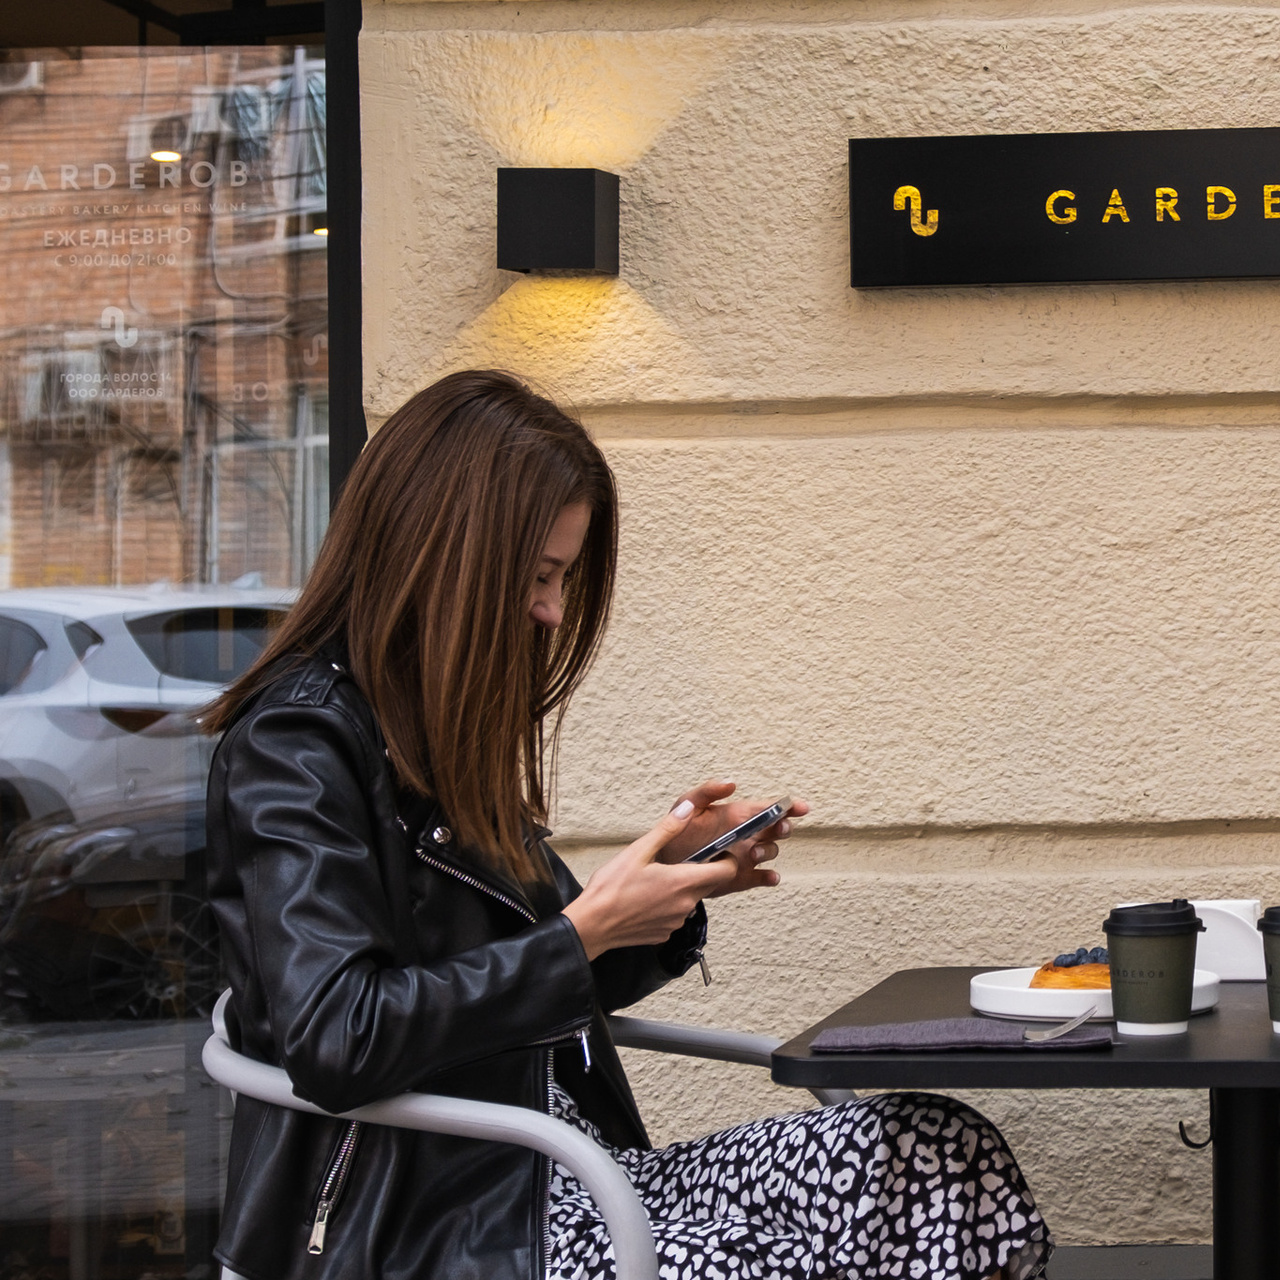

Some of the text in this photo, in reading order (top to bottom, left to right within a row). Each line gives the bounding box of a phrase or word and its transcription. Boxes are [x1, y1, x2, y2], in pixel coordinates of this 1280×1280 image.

[0, 202, 247, 218] OASTERY BAKERY KITCHEN WINE
[43, 227, 192, 248] ЕЖЕДНЕВНО
[54, 253, 176, 268] С 9:00 ДО 21:00
[60, 373, 110, 384] ГОРОДА
[114, 372, 158, 383] ВОЛОС
[68, 387, 164, 398] ООО ГАРДЕРОБ
